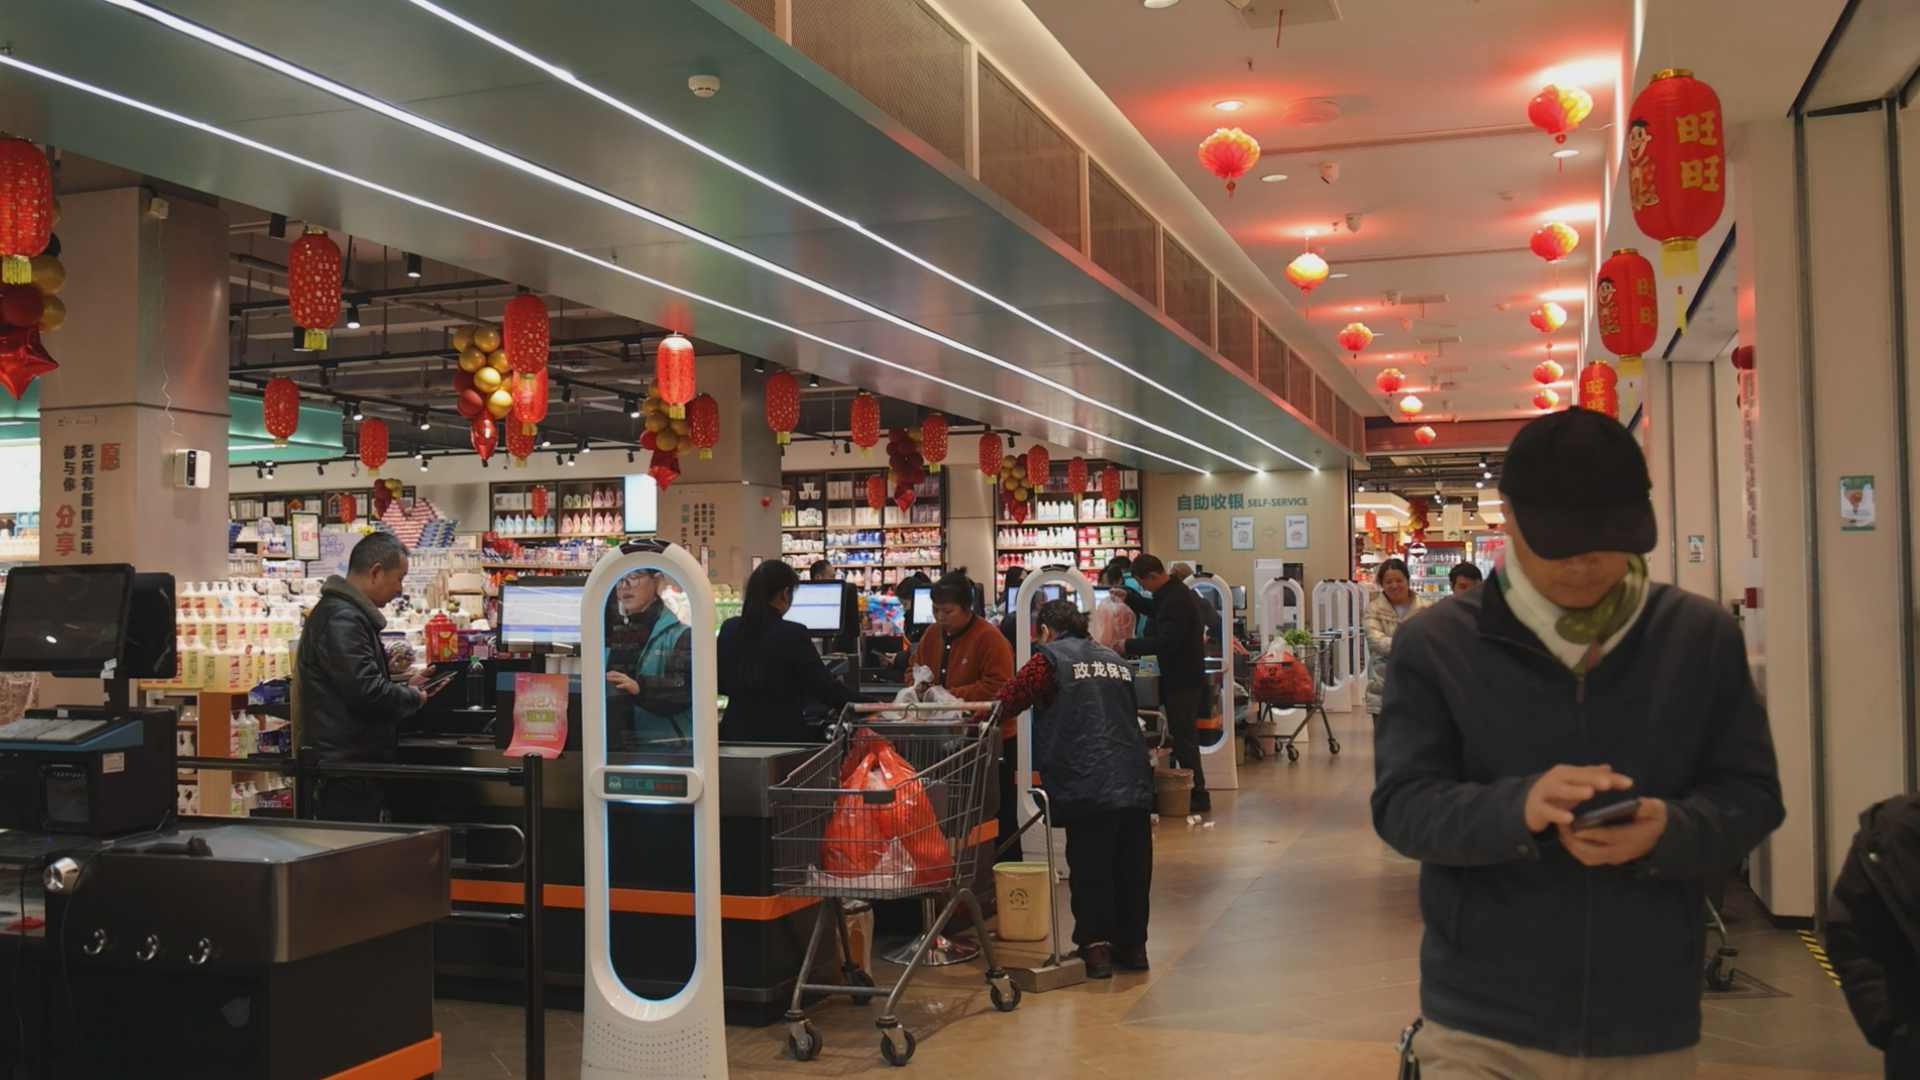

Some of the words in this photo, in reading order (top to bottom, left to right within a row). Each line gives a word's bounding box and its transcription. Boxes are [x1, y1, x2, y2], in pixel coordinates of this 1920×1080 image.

[1676, 110, 1719, 192] 旺旺
[63, 445, 76, 492] 都与你
[100, 443, 121, 471] 愿
[81, 444, 95, 556] 把所有新鲜滋味
[1178, 493, 1244, 511] 自助收银
[1248, 497, 1308, 508] SELF-SERVICE
[55, 504, 76, 556] 分享
[1072, 661, 1132, 682] 政龙保洁
